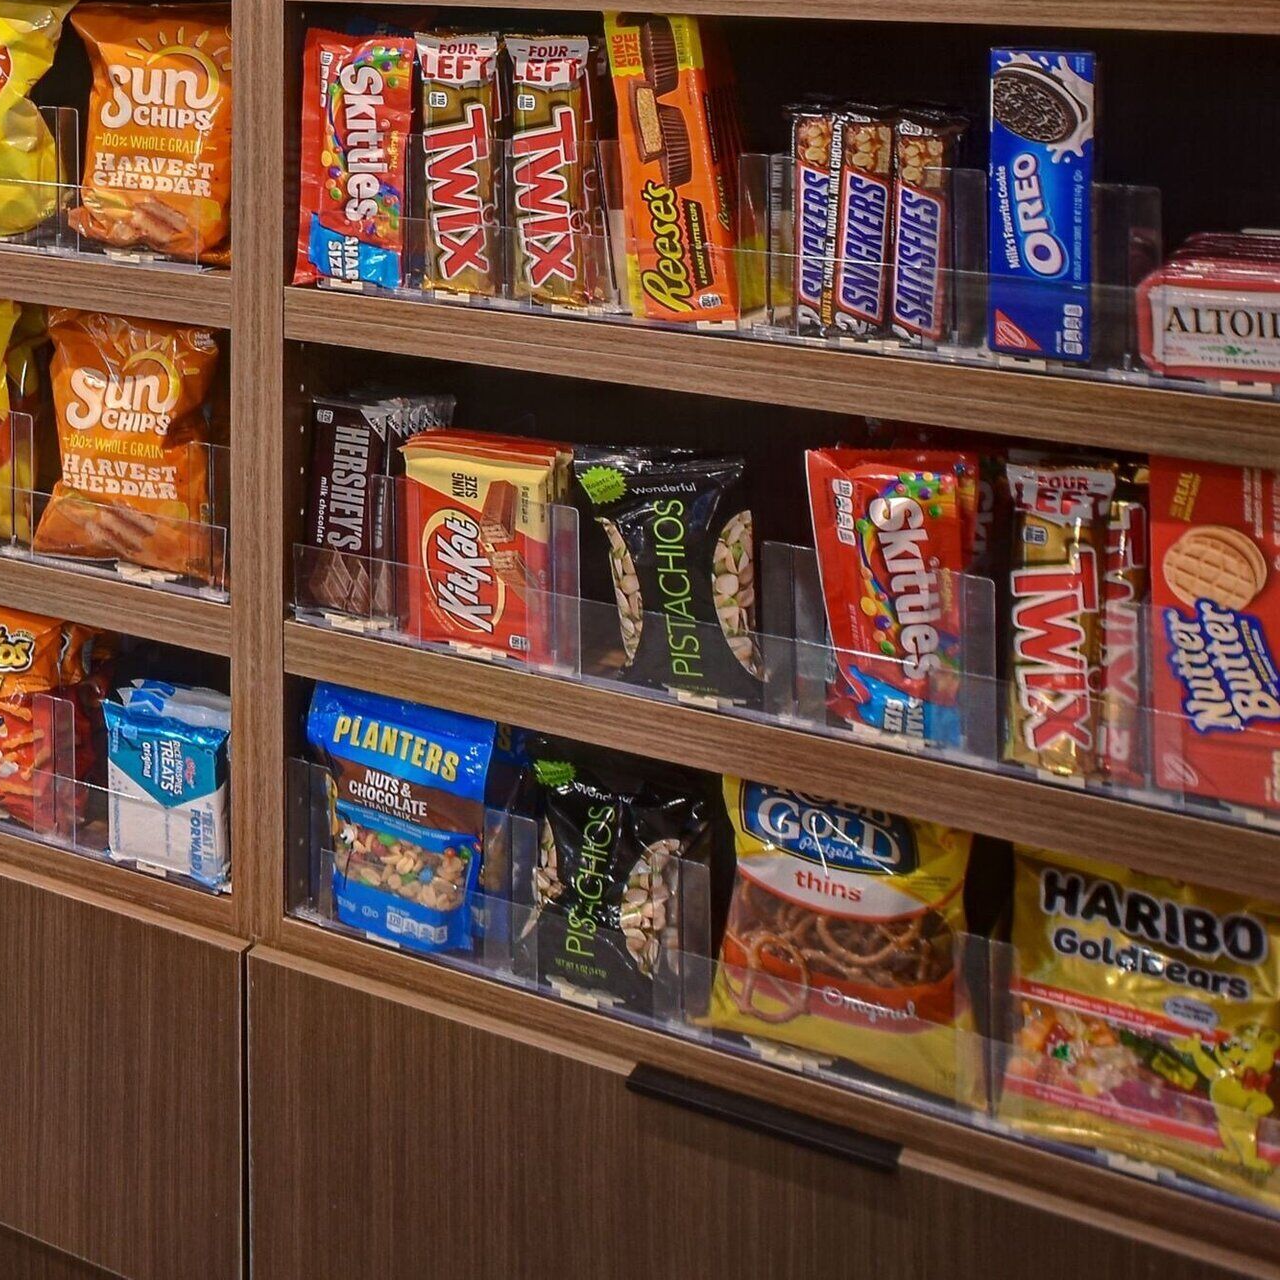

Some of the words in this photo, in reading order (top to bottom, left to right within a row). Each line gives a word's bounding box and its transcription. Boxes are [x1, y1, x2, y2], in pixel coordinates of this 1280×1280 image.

[422, 55, 494, 80] LEFT
[439, 43, 478, 55] FOUR
[612, 35, 623, 68] KING
[624, 33, 640, 68] SIZE
[130, 136, 166, 150] WHOLE
[168, 138, 204, 154] GRAIN
[132, 106, 214, 131] CHIPS
[341, 64, 388, 222] Skittles
[92, 171, 211, 198] CHEDDAR
[95, 153, 215, 180] HARVEST
[424, 103, 488, 279] TWIX
[641, 179, 692, 312] Reese's
[842, 172, 886, 315] SNICKERS
[1014, 153, 1063, 275] OREO
[327, 425, 370, 550] HERSHEY'S
[631, 482, 697, 496] Wonderful
[654, 499, 703, 679] PISTACHIOS
[1012, 546, 1098, 751] TWIX
[160, 741, 174, 791] TREATS
[334, 716, 460, 783] PLANTERS
[349, 781, 428, 817] CHOCOLATE
[191, 808, 202, 876] FORWARD
[1041, 869, 1268, 964] HARIBO
[1053, 928, 1249, 999] Goldbears
